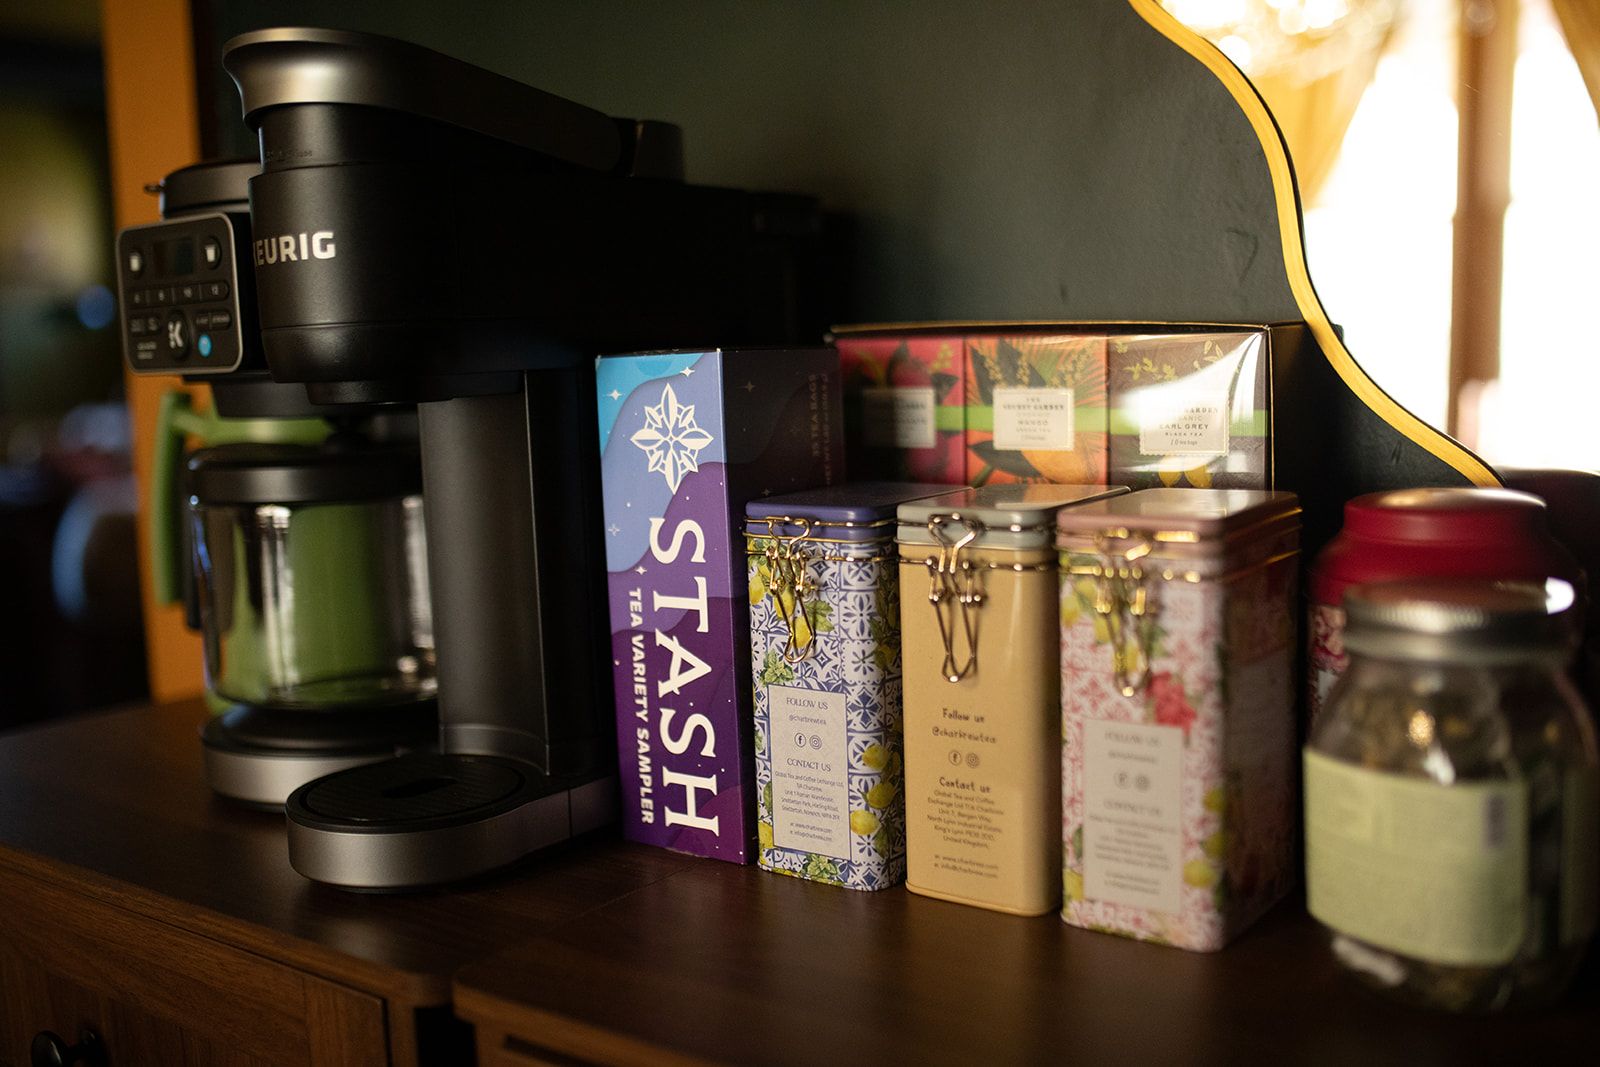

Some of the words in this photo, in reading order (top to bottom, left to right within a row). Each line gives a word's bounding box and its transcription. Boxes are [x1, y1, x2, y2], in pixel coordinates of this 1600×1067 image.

[254, 231, 336, 266] EURIG
[628, 588, 642, 628] TEA
[631, 635, 648, 721] VARIETY
[649, 517, 720, 836] STASH
[786, 697, 815, 708] FOLLOW
[818, 702, 829, 710] US
[943, 708, 970, 720] Follow
[932, 726, 997, 744] @charbrewtea
[636, 729, 654, 824] SAMPLER
[787, 758, 819, 770] CONTACT
[821, 763, 831, 772] US
[939, 776, 975, 791] Contact
[980, 785, 991, 793] us
